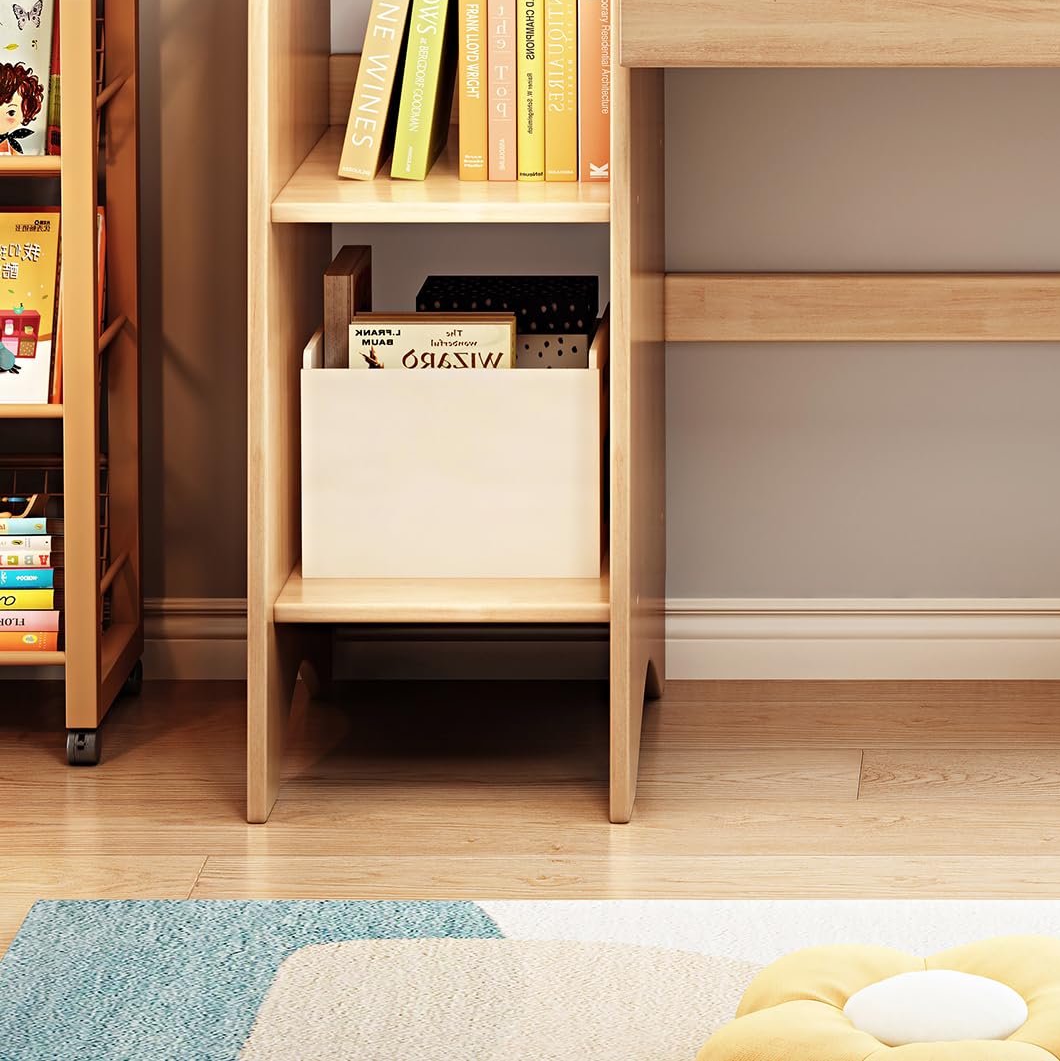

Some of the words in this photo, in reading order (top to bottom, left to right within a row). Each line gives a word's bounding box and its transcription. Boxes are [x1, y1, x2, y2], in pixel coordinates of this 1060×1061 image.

[465, 3, 479, 32] FRANK
[466, 34, 479, 62] LLOYD
[601, 24, 611, 66] Residential
[414, 45, 429, 88] BERGDORF
[466, 64, 480, 100] WRIGHT
[351, 53, 391, 150] WINES
[409, 89, 424, 132] GOODMAN
[601, 68, 611, 114] Architecture
